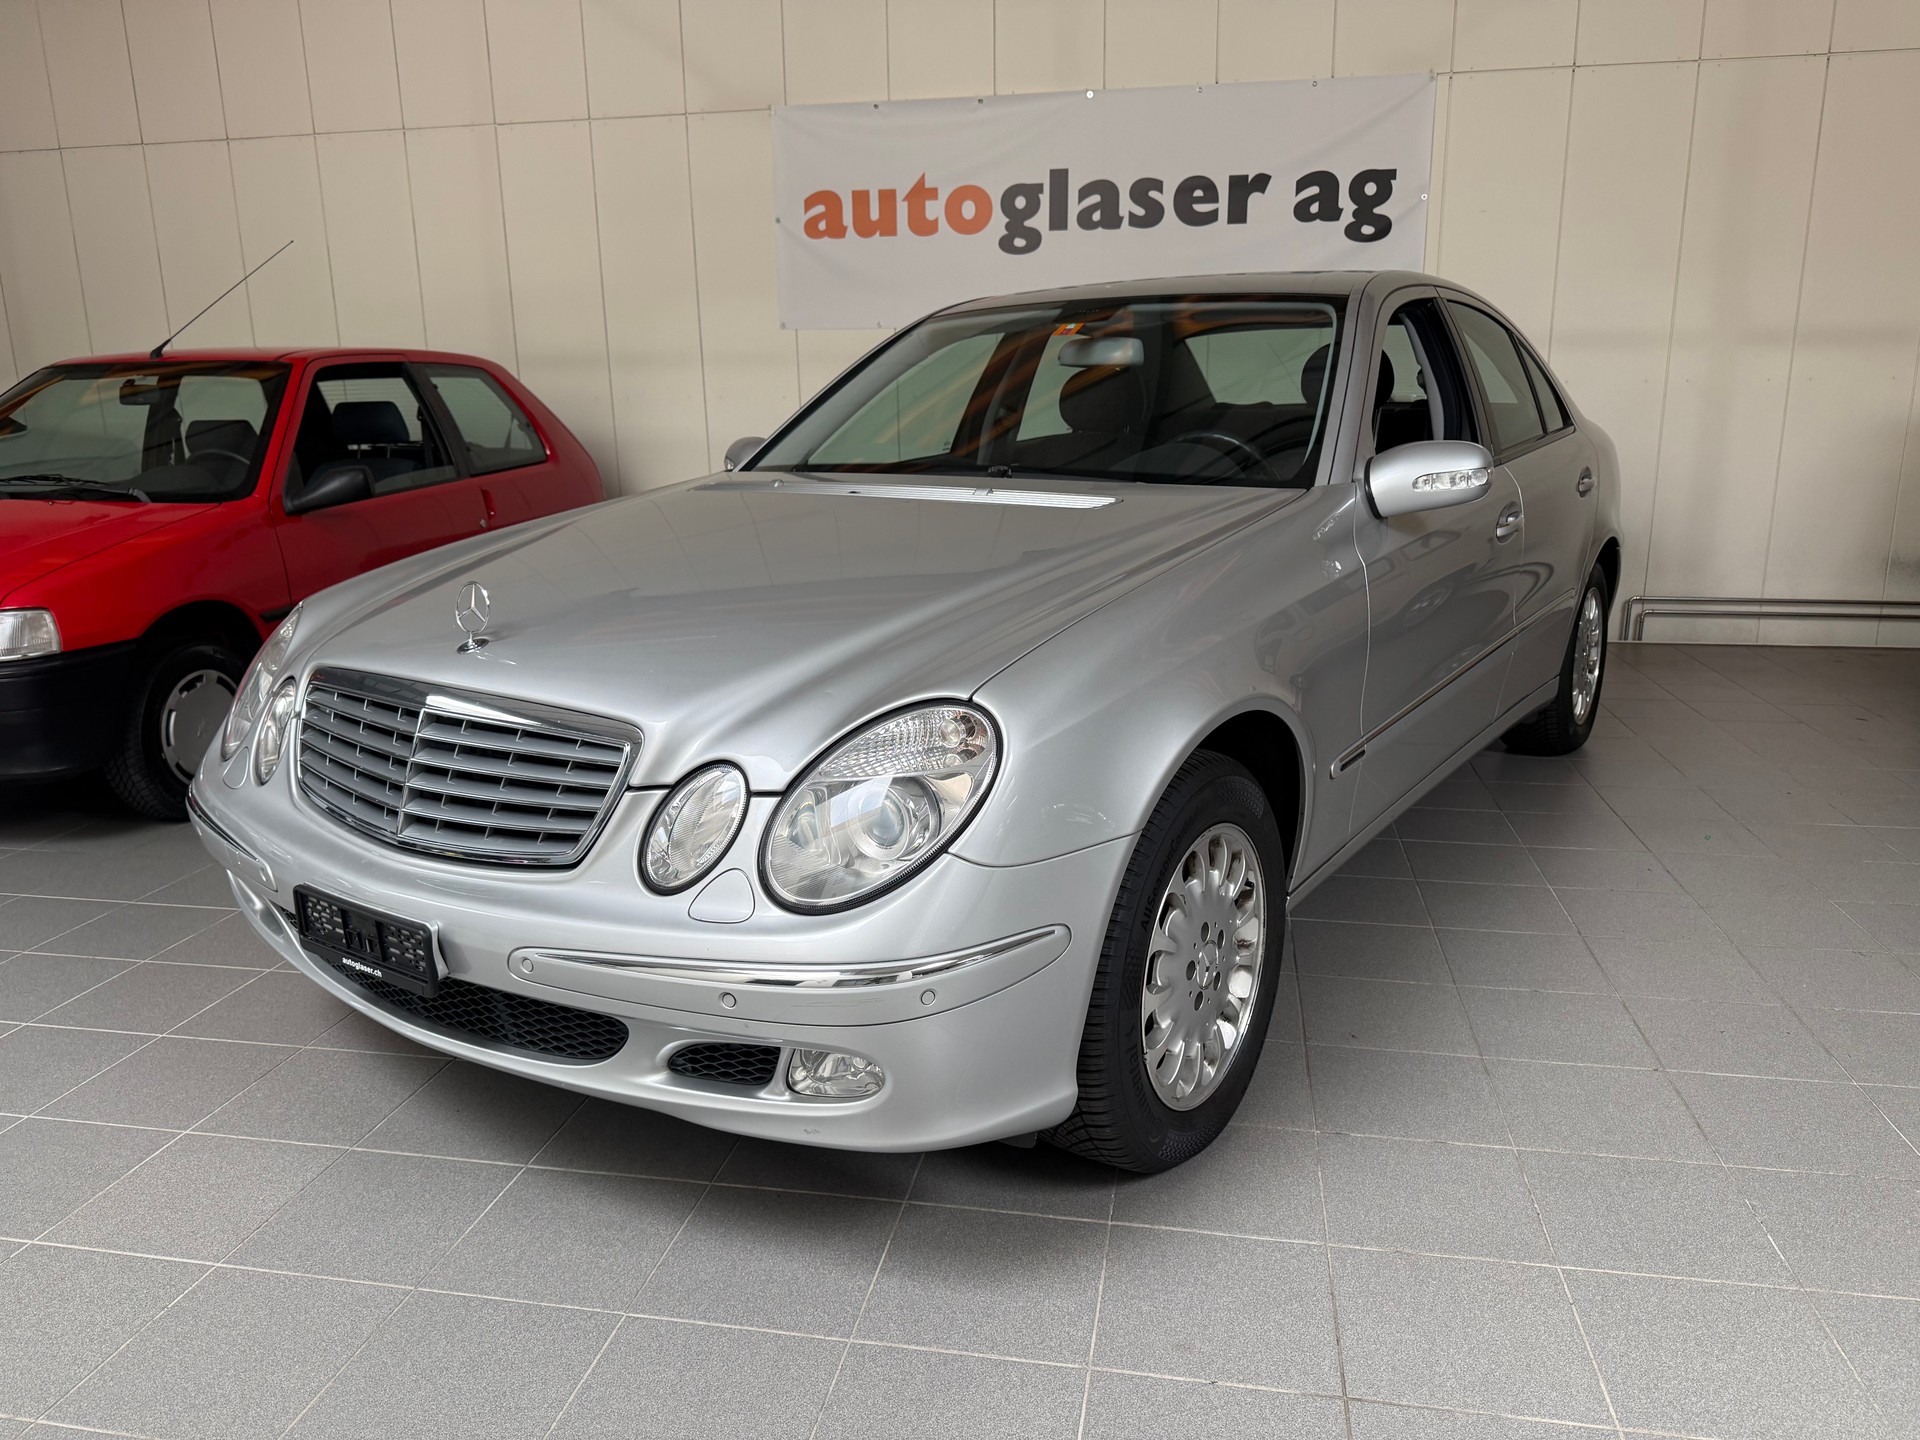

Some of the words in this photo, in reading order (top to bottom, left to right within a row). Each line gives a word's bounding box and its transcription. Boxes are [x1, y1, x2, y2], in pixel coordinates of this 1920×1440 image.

[803, 168, 1272, 256] autoglaser
[1293, 168, 1398, 243] ag
[342, 956, 382, 978] autoglaser.ch
